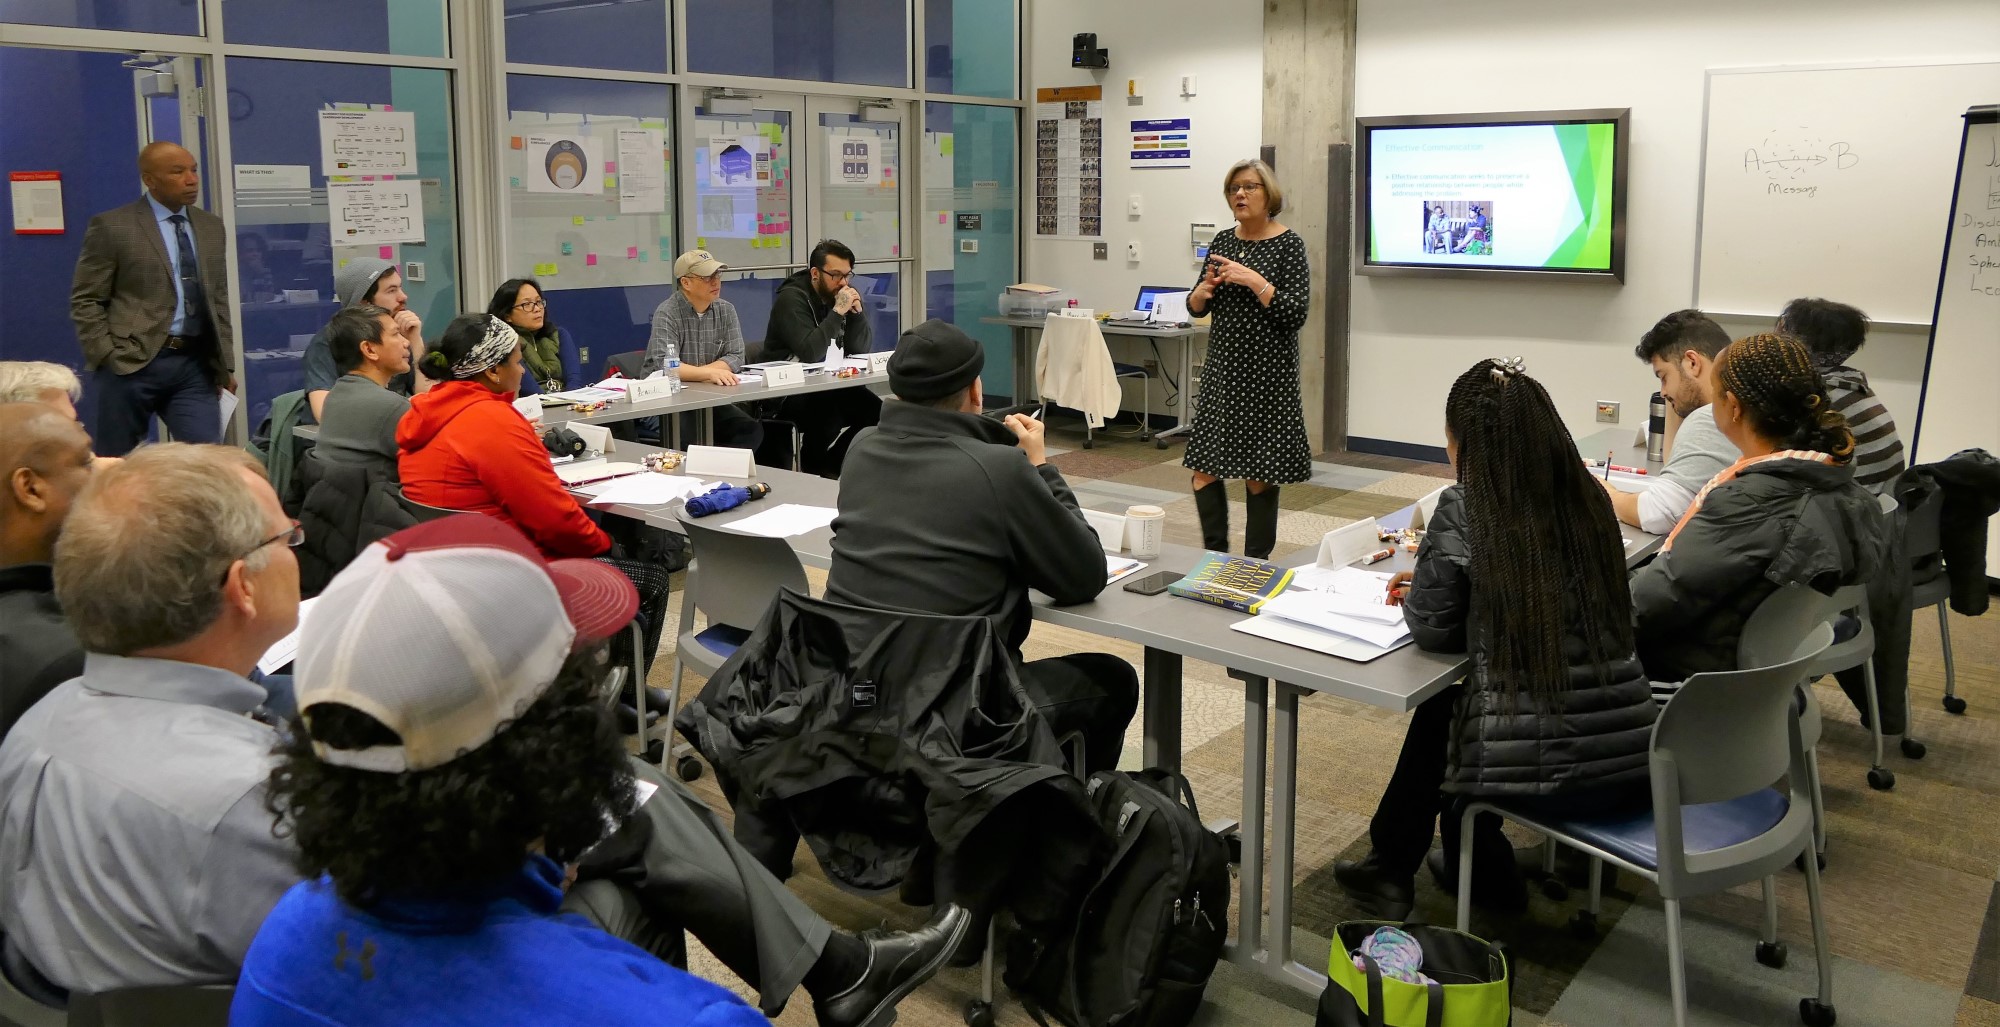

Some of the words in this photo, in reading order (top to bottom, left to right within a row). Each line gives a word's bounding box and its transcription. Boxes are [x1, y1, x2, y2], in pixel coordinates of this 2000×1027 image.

[1385, 144, 1420, 152] Effective
[1422, 143, 1483, 151] Communication
[1744, 148, 1760, 173] A
[1829, 142, 1859, 169] B
[1767, 183, 1817, 197] Message
[699, 252, 709, 260] W
[779, 371, 787, 380] Li
[1194, 558, 1225, 581] NEW
[1221, 567, 1276, 602] MNUAL
